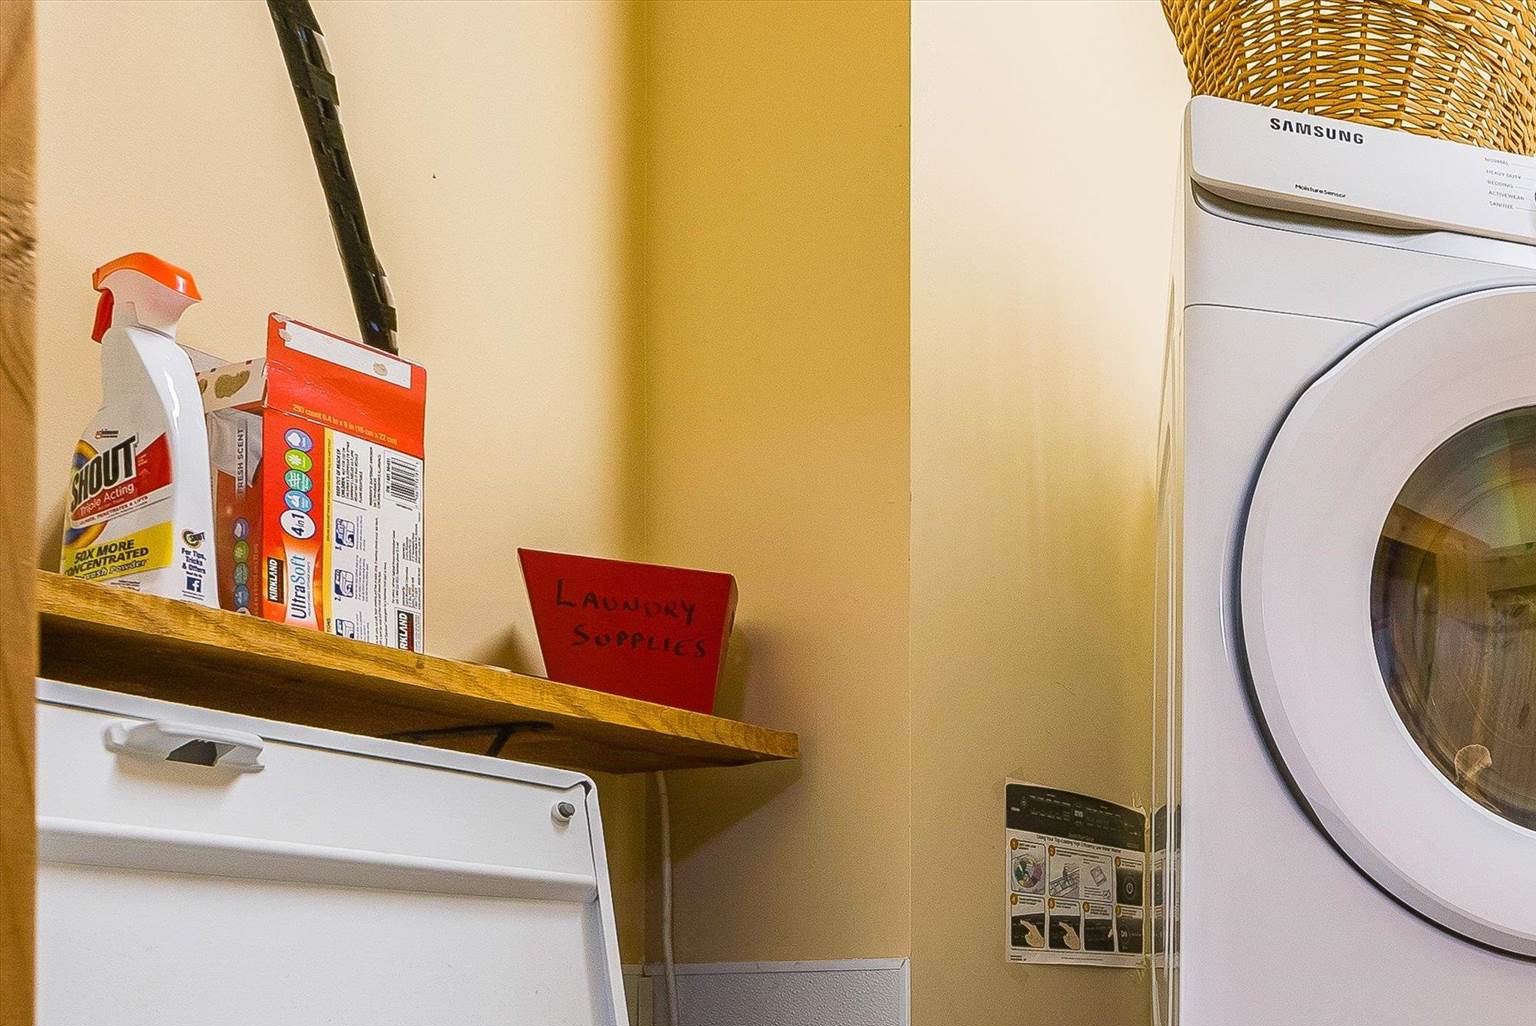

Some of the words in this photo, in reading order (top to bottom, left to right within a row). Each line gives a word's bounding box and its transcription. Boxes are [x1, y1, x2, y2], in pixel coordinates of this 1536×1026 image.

[1270, 118, 1363, 144] SAMSUNG
[71, 435, 137, 511] SHOUT
[103, 483, 134, 503] Acting
[75, 550, 95, 563] 50X
[98, 540, 135, 556] MORE
[186, 556, 203, 567] Tricks
[268, 559, 278, 601] KIRKLAND
[291, 555, 307, 618] UltraSoft
[556, 579, 697, 625] LAUNDRY
[399, 613, 408, 650] RKLAND
[572, 624, 706, 659] SUPPLIES
